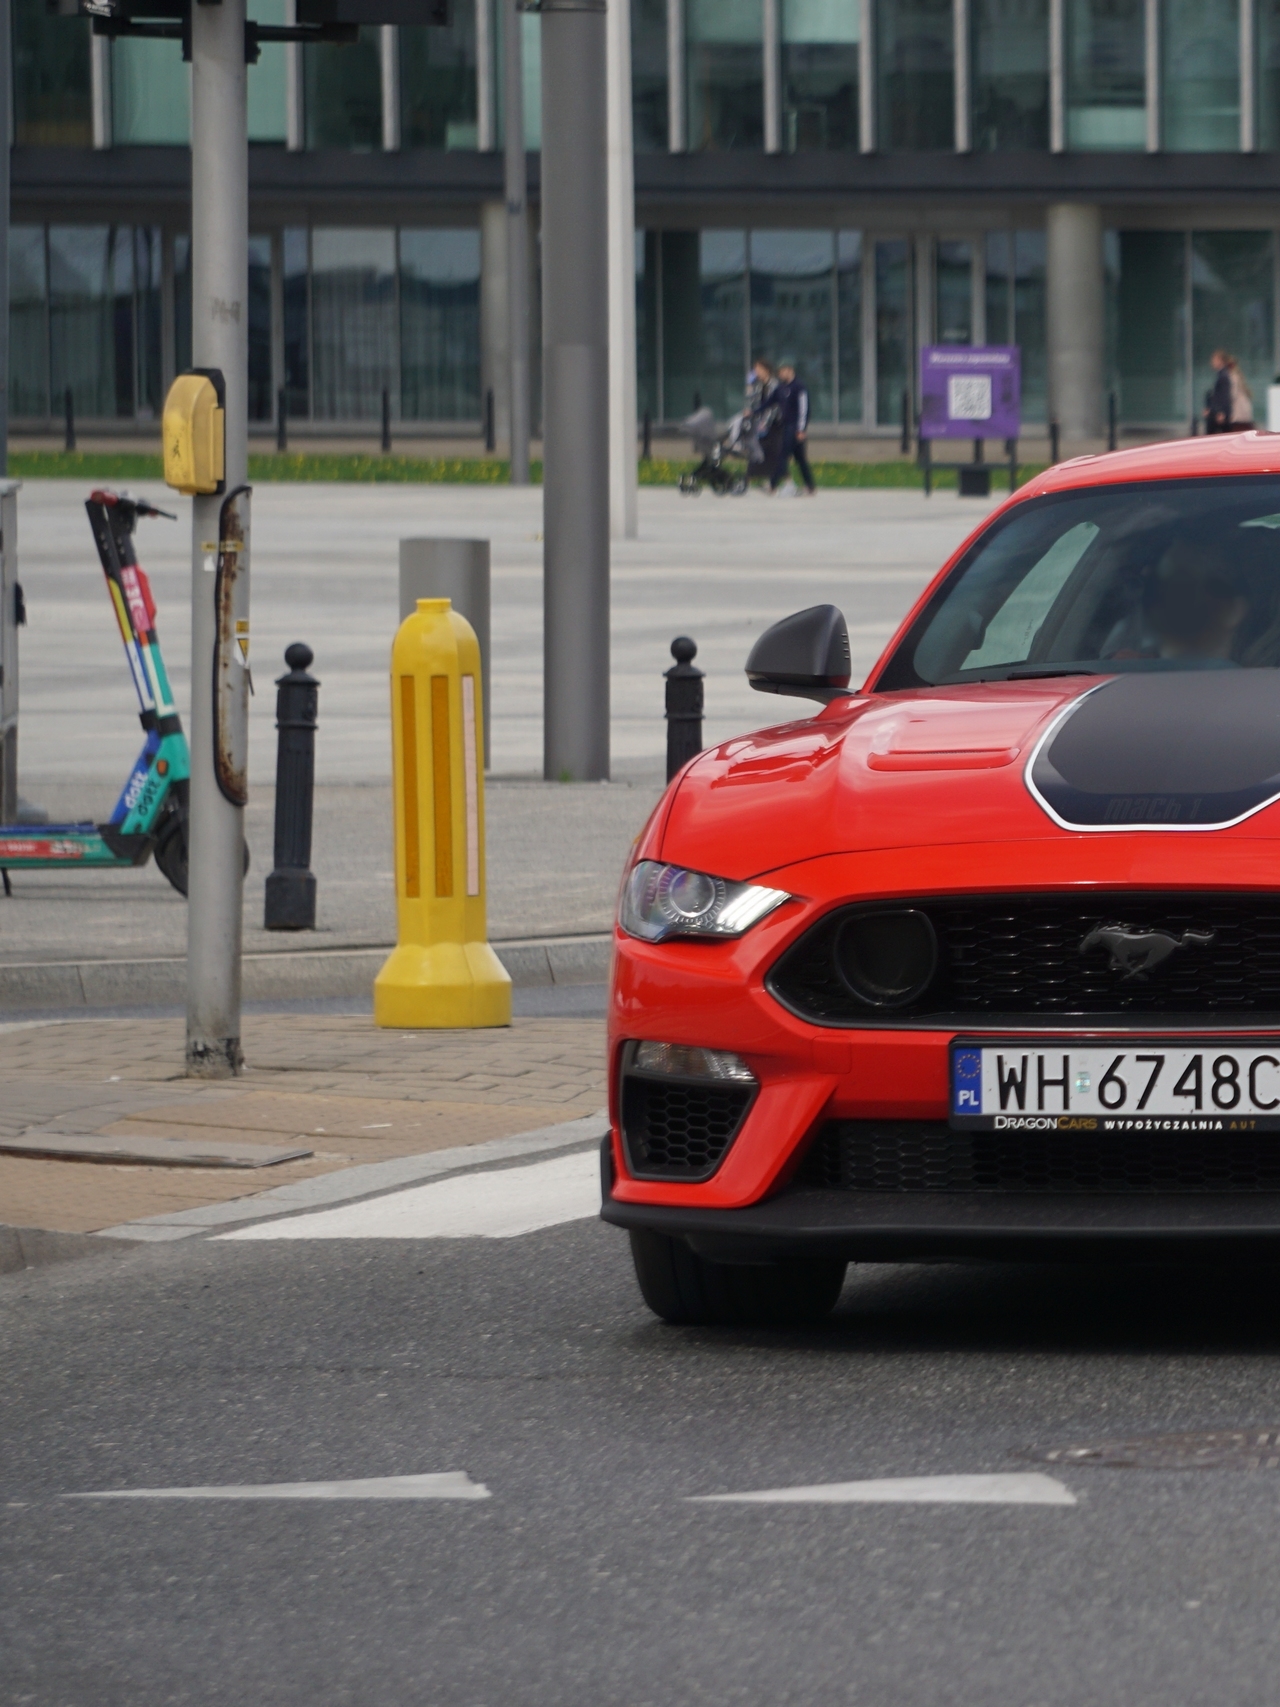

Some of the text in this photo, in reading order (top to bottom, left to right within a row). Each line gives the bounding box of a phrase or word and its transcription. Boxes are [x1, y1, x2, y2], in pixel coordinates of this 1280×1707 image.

[1189, 797, 1203, 820] 1
[996, 1054, 1071, 1110] WH
[958, 1090, 979, 1107] PL
[1104, 1119, 1224, 1130] WYPOŻYCZALNIA
[1229, 1120, 1256, 1130] AUT
